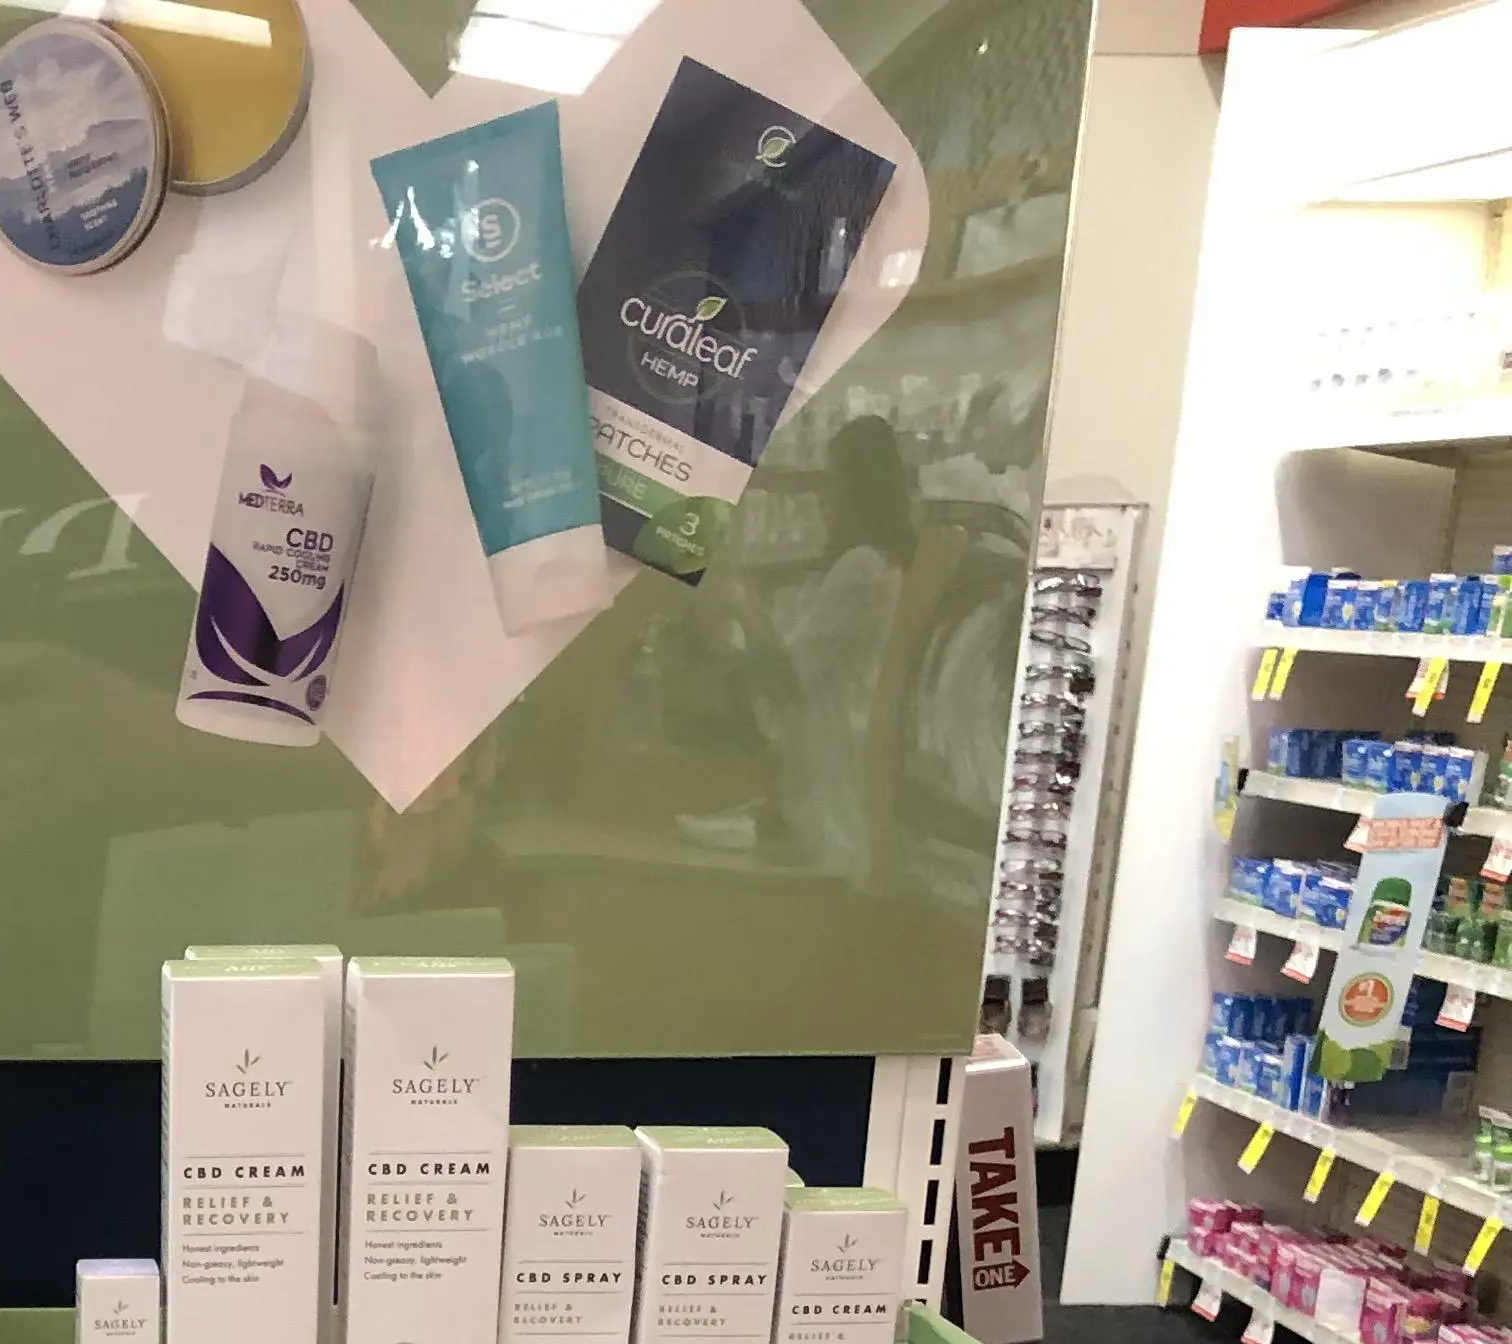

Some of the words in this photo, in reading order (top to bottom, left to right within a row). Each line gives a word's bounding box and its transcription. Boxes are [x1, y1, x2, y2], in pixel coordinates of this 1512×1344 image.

[620, 296, 759, 380] curaleaf
[640, 351, 699, 389] HEMP
[239, 492, 305, 517] MEDTERRA
[680, 513, 699, 536] 3
[286, 528, 334, 552] CBD
[268, 565, 327, 590] 250mg
[205, 1082, 287, 1098] SAGELY
[392, 1078, 474, 1095] SAGELY
[183, 1166, 223, 1179] CBD
[235, 1166, 306, 1179] CREAM
[367, 1163, 407, 1176] CBD
[420, 1163, 491, 1175] CREAM
[367, 1193, 434, 1205] RELIEF
[447, 1192, 458, 1204] &
[968, 1126, 1020, 1261] TAKE
[183, 1197, 251, 1209] RELIEF
[262, 1197, 273, 1208] &
[183, 1213, 290, 1226] RECOVERY
[366, 1209, 475, 1223] RECOVERY
[538, 1214, 607, 1228] SAGELY
[686, 1216, 754, 1230] SAGELY
[365, 1240, 394, 1250] Honest
[810, 1259, 878, 1272] SAGELY
[516, 1272, 552, 1284] CBD
[562, 1272, 622, 1284] SPRAY
[662, 1274, 697, 1286] CBD
[708, 1274, 768, 1286] SPRAY
[975, 1267, 1016, 1287] ONE
[792, 1305, 823, 1315] CBD
[832, 1304, 888, 1315] CREAM
[94, 1319, 145, 1330] SAGELY
